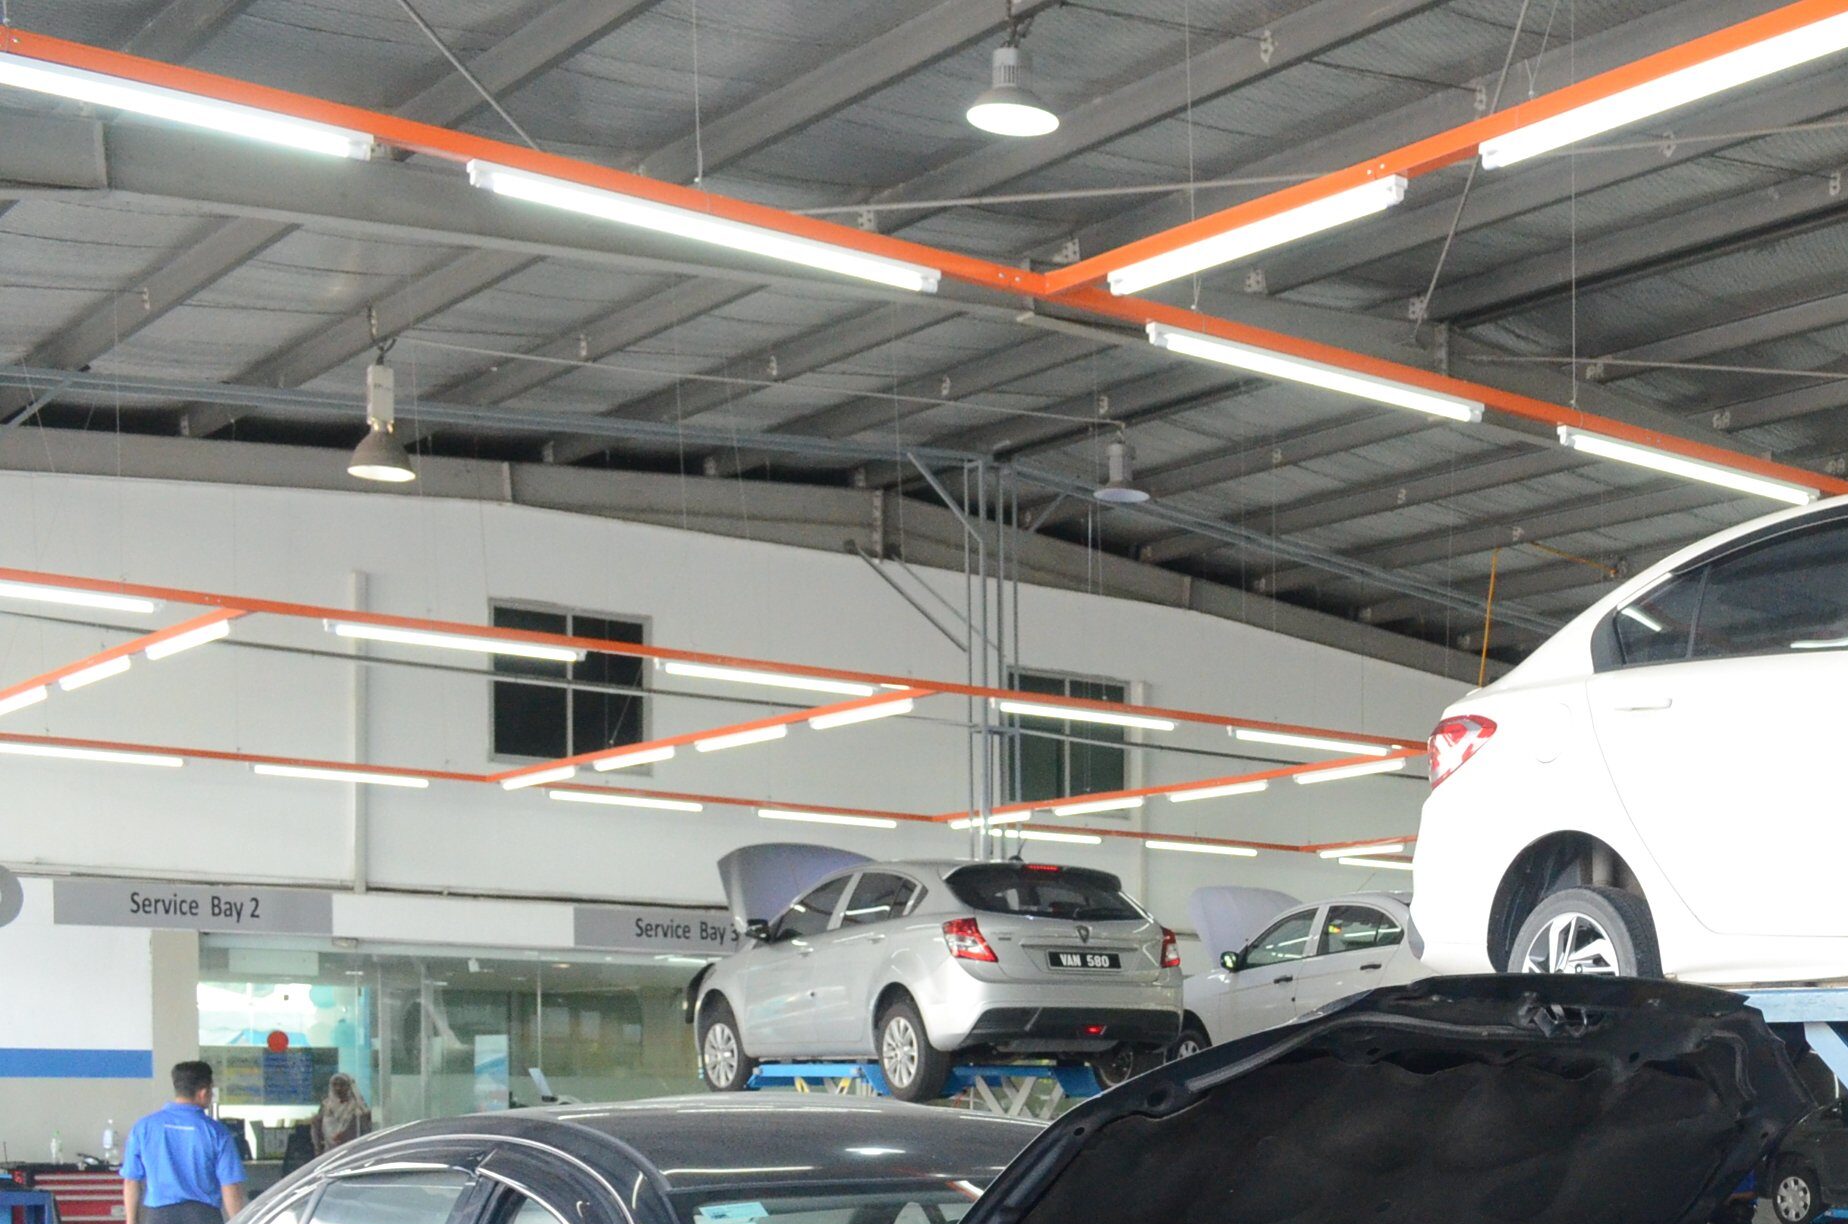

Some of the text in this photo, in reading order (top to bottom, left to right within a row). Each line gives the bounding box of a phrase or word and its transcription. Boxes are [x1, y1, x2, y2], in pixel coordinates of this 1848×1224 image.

[130, 892, 260, 923] Service Bay 2
[635, 917, 739, 945] Service Bay 3
[1060, 953, 1110, 967] VAN 580
